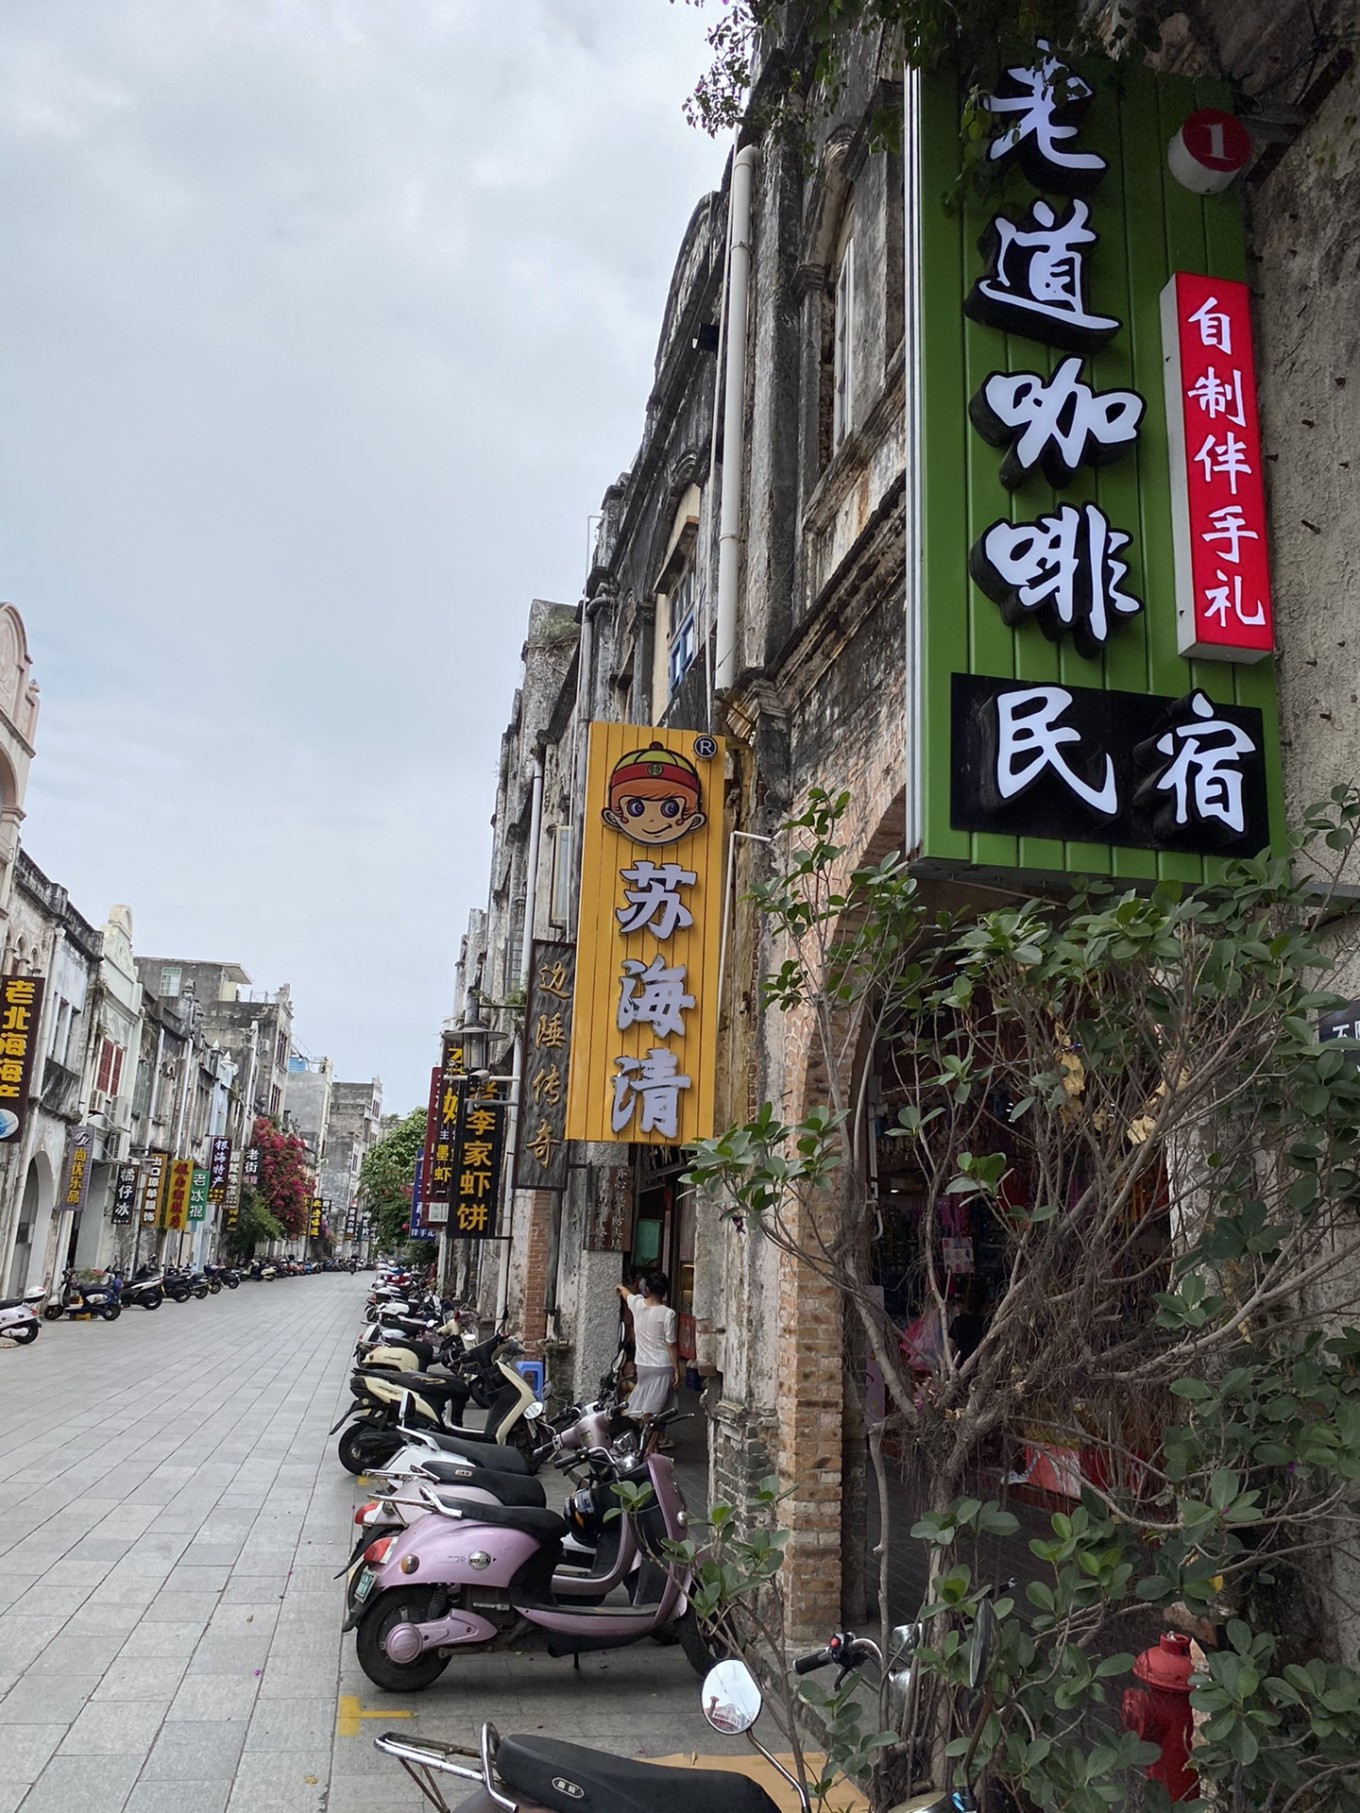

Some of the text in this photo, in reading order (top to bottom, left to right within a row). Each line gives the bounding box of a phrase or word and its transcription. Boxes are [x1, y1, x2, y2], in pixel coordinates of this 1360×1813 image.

[979, 40, 1142, 641] 老道咖啡
[1187, 297, 1266, 627] 自制伴手礼
[997, 686, 1257, 833] 民宿
[611, 860, 697, 1139] 苏海清
